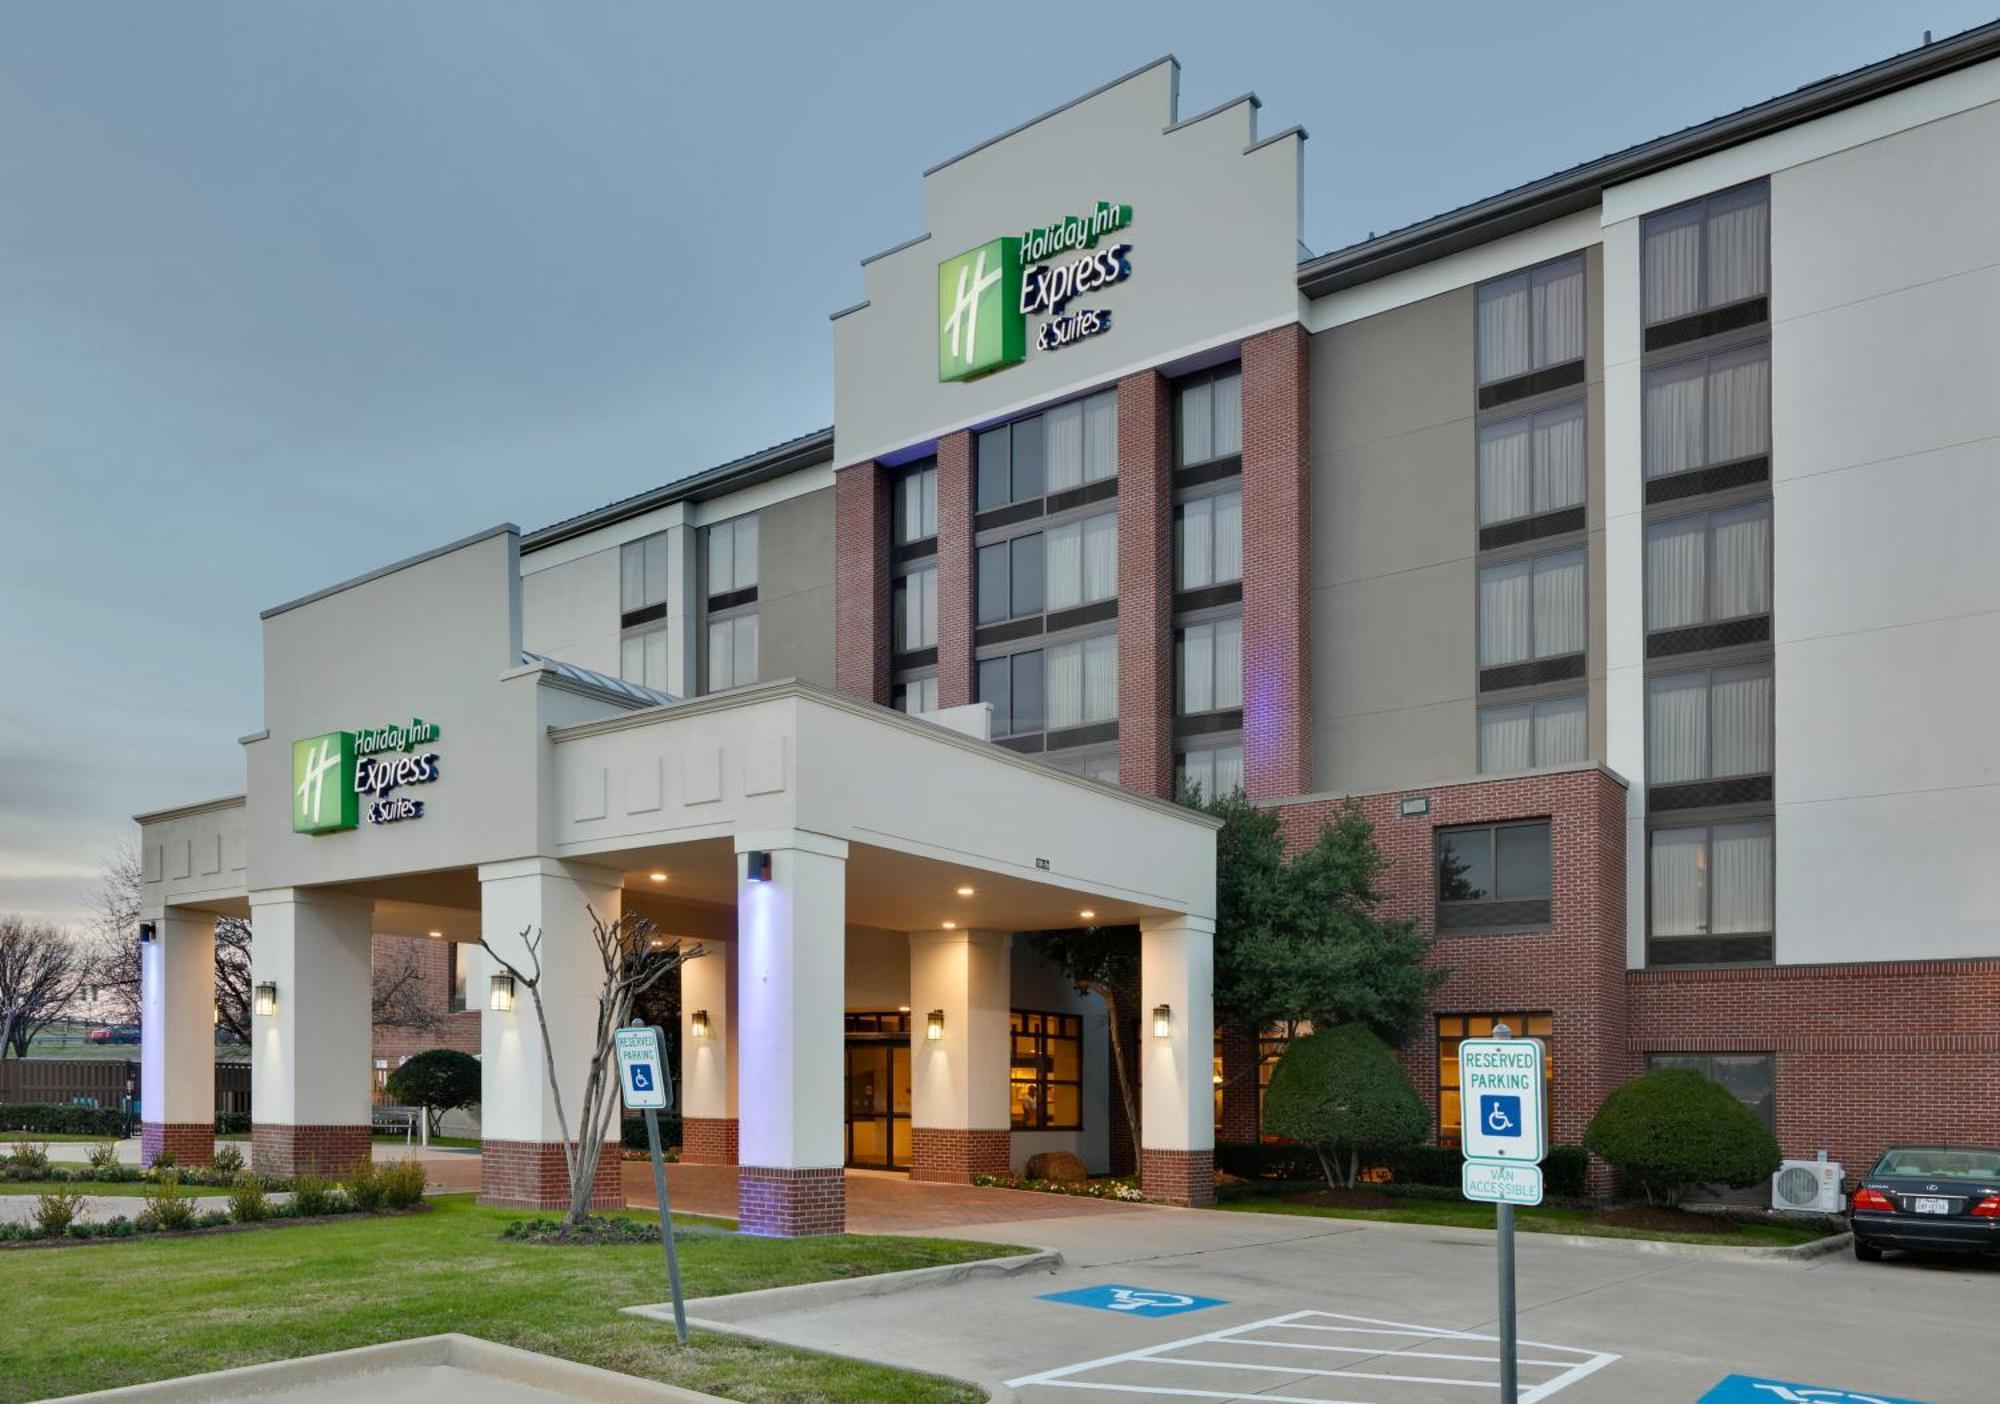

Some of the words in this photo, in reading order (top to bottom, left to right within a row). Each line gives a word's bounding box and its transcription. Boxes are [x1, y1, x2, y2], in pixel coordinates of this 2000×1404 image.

[1019, 216, 1092, 265] Holiday
[1092, 201, 1127, 236] Inn
[1019, 244, 1126, 315] Express
[1036, 322, 1050, 351] &
[1051, 309, 1106, 347] Suites
[354, 724, 408, 755] Holiday
[409, 718, 435, 743] Inn
[354, 752, 435, 798] Express
[367, 803, 378, 823] &
[378, 798, 420, 822] Suites
[617, 1036, 654, 1047] RESERVED
[623, 1050, 655, 1060] PARKING
[1466, 1052, 1533, 1069] RESERVED
[1471, 1073, 1530, 1090] PARKING
[1490, 1169, 1514, 1182] VAN
[1469, 1181, 1537, 1197] ACCESSIBLE
